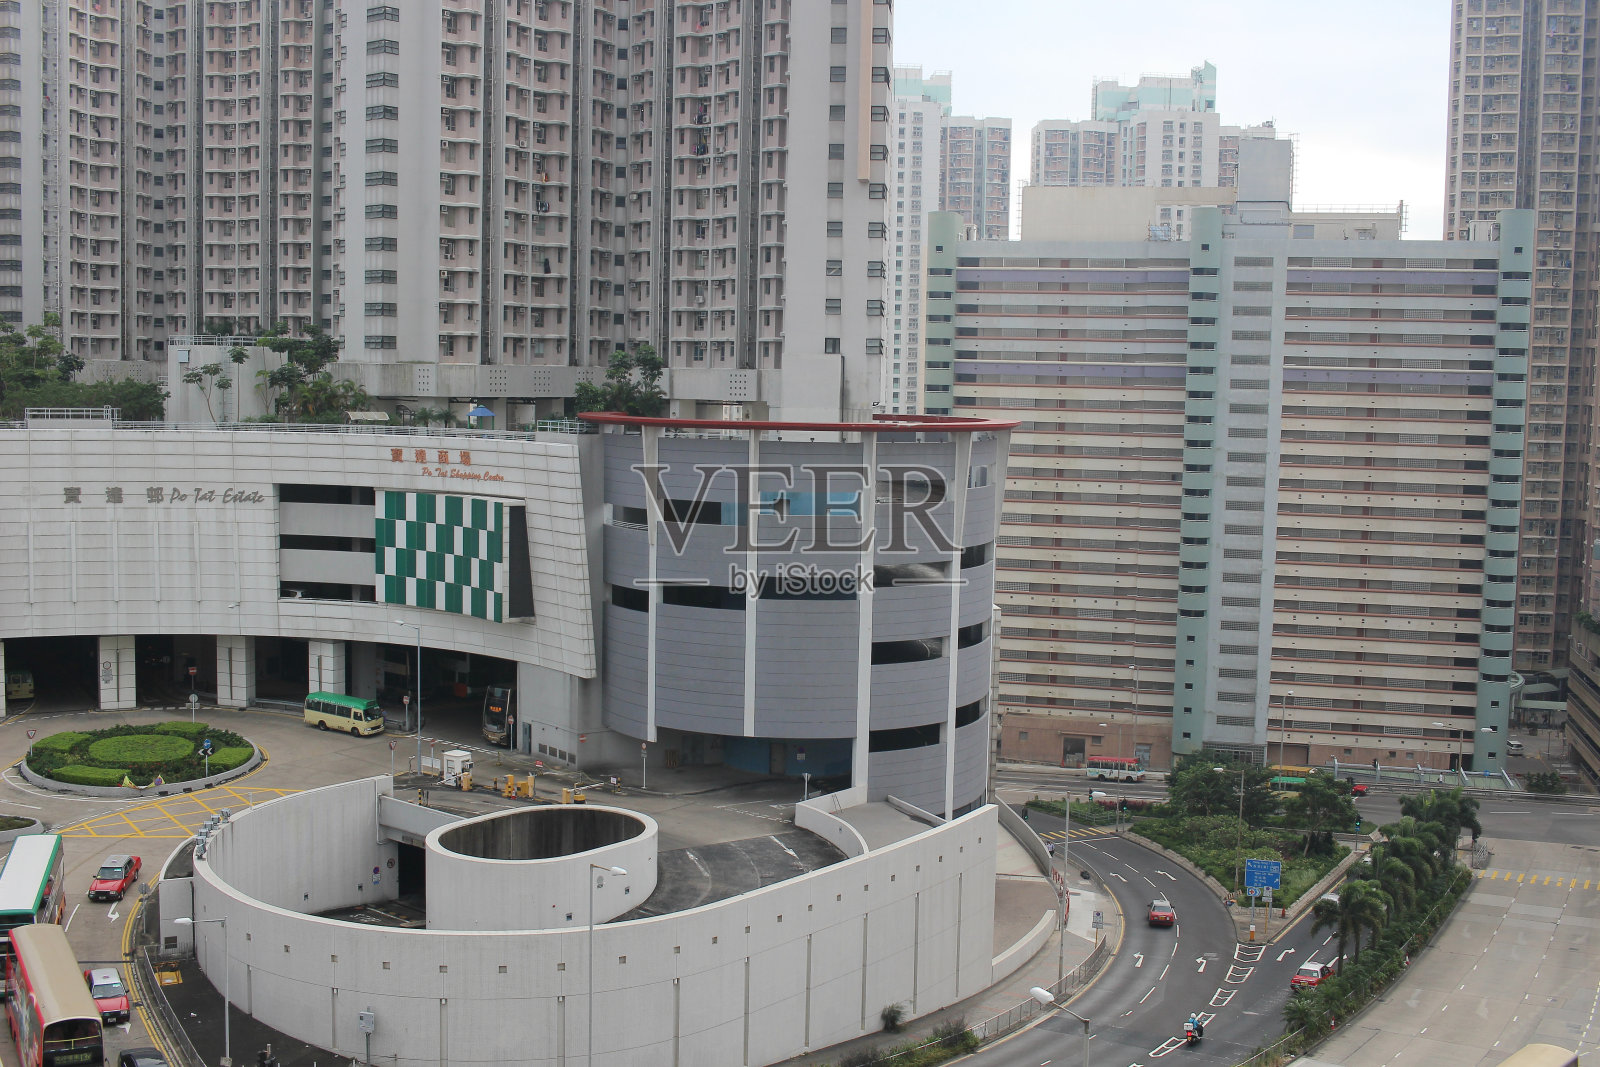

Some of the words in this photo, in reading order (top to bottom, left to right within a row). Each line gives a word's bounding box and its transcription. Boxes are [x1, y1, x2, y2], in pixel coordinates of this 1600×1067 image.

[422, 467, 432, 476] Po
[450, 468, 481, 481] Shopping
[483, 471, 504, 482] Centre
[170, 487, 188, 504] Po
[194, 487, 216, 504] Tat
[222, 487, 265, 504] Estate
